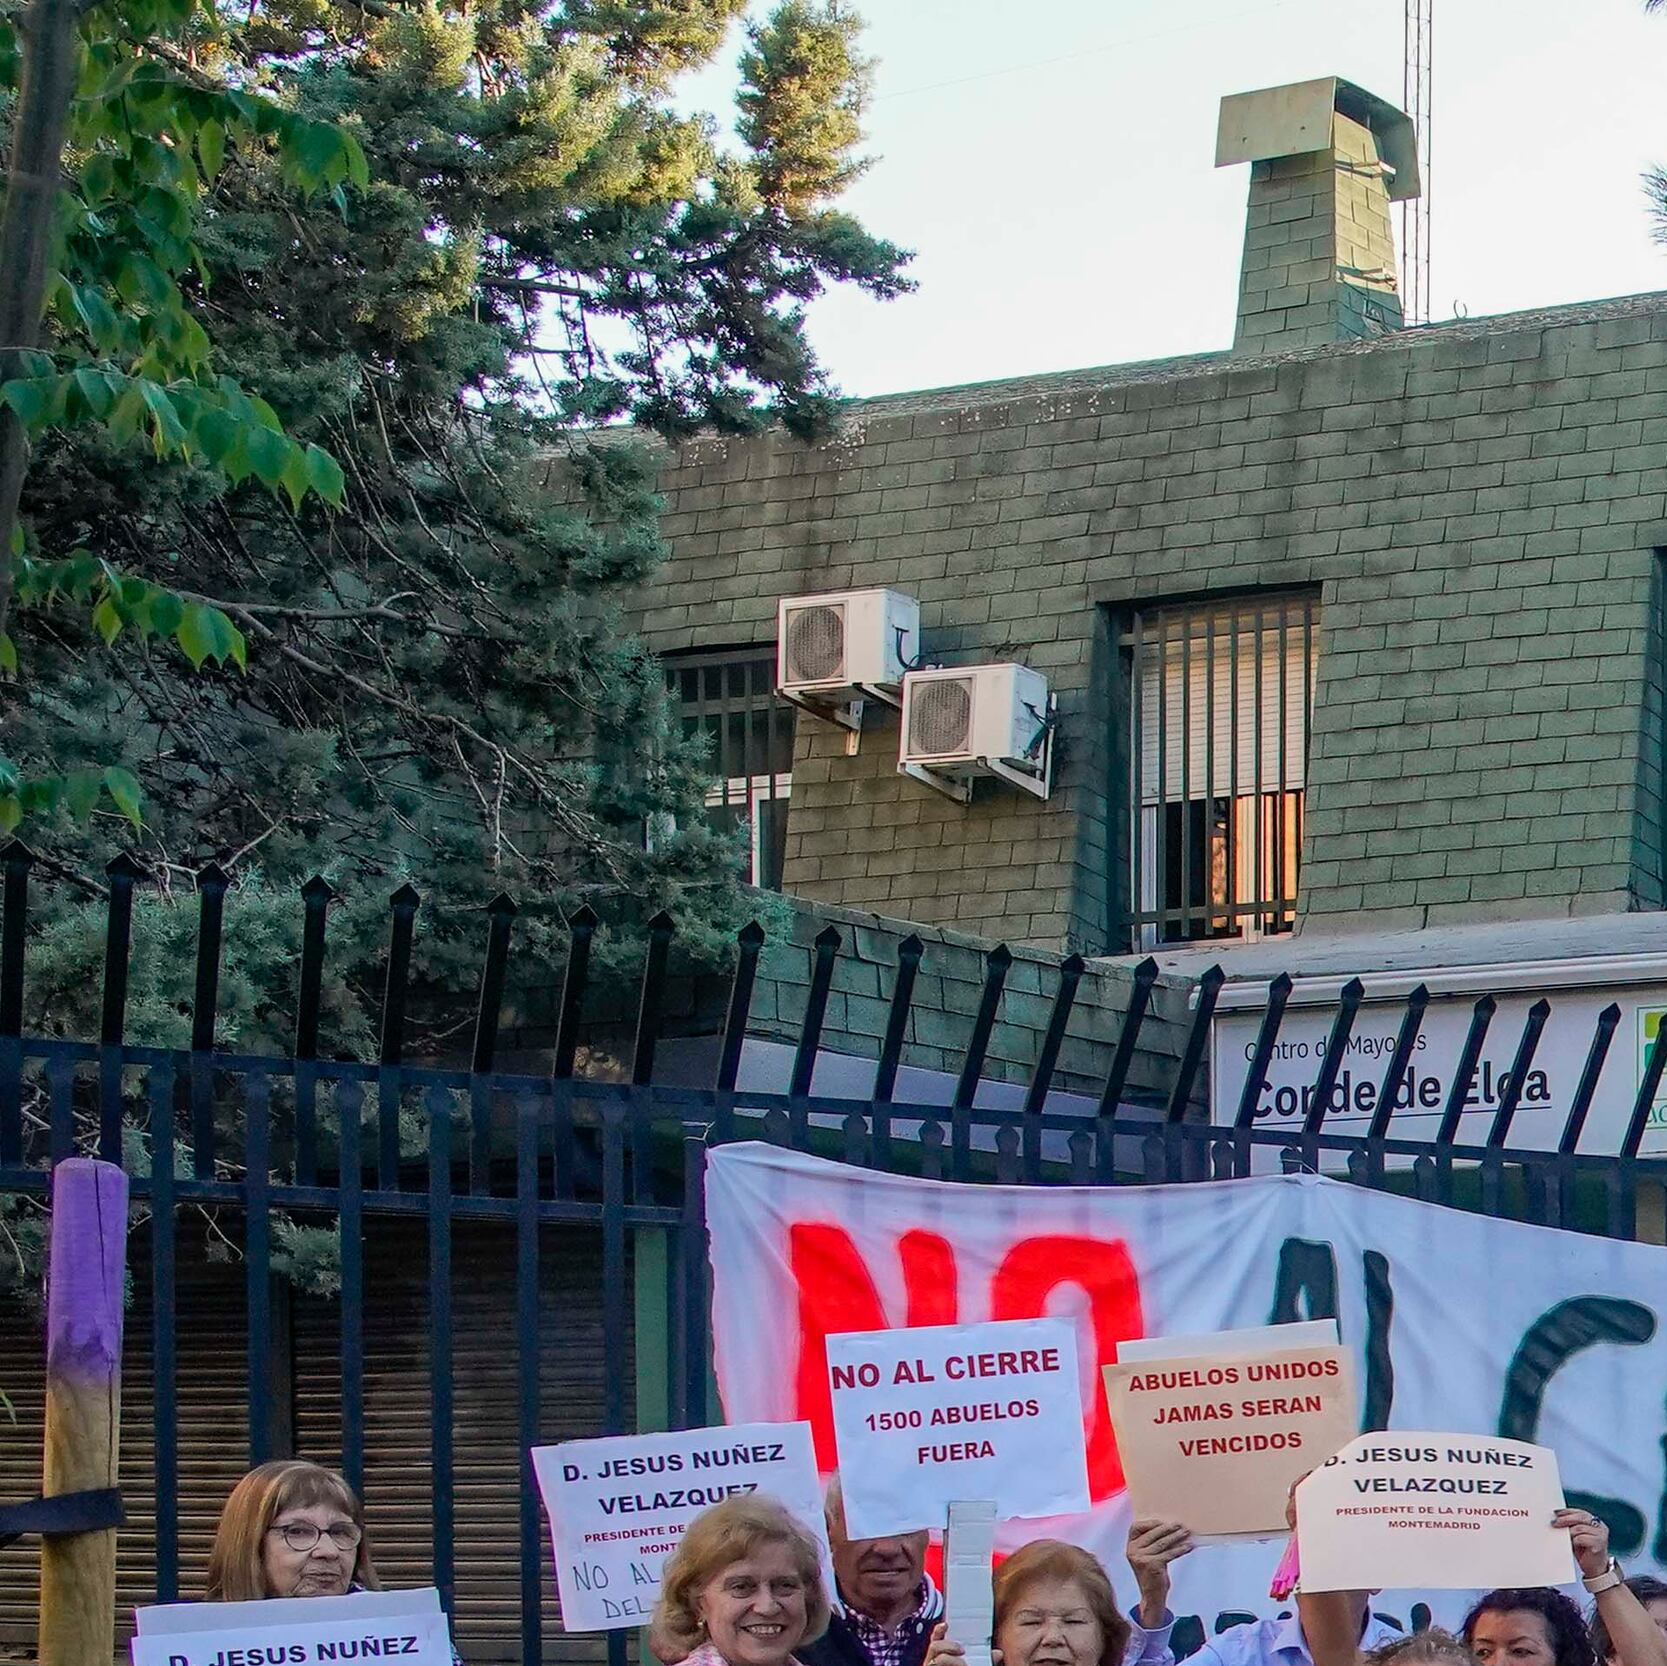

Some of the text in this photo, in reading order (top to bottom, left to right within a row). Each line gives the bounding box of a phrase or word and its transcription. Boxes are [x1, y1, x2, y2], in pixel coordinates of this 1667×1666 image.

[1245, 1041, 1309, 1062] Cntro
[832, 1349, 1059, 1389] NO AL CIERRE
[1129, 1360, 1338, 1391] ABUELOS UNIDOS
[866, 1400, 1039, 1431] 1500 ABUELOS
[1154, 1396, 1321, 1424] JAMAS SERAN
[918, 1441, 995, 1464] FUERA
[1179, 1432, 1301, 1456] VENCIDOS
[563, 1444, 785, 1481] D. JESUS NUÑEZ
[1356, 1448, 1438, 1462] JESUS
[1448, 1449, 1533, 1468] NUÑEZ
[1354, 1478, 1508, 1494] VELAZQUEZ
[585, 1525, 685, 1542] PRESIDENTE DE
[573, 1561, 660, 1591] NO AL
[602, 1596, 654, 1618] DEL
[317, 1636, 419, 1660] NUÑEZ
